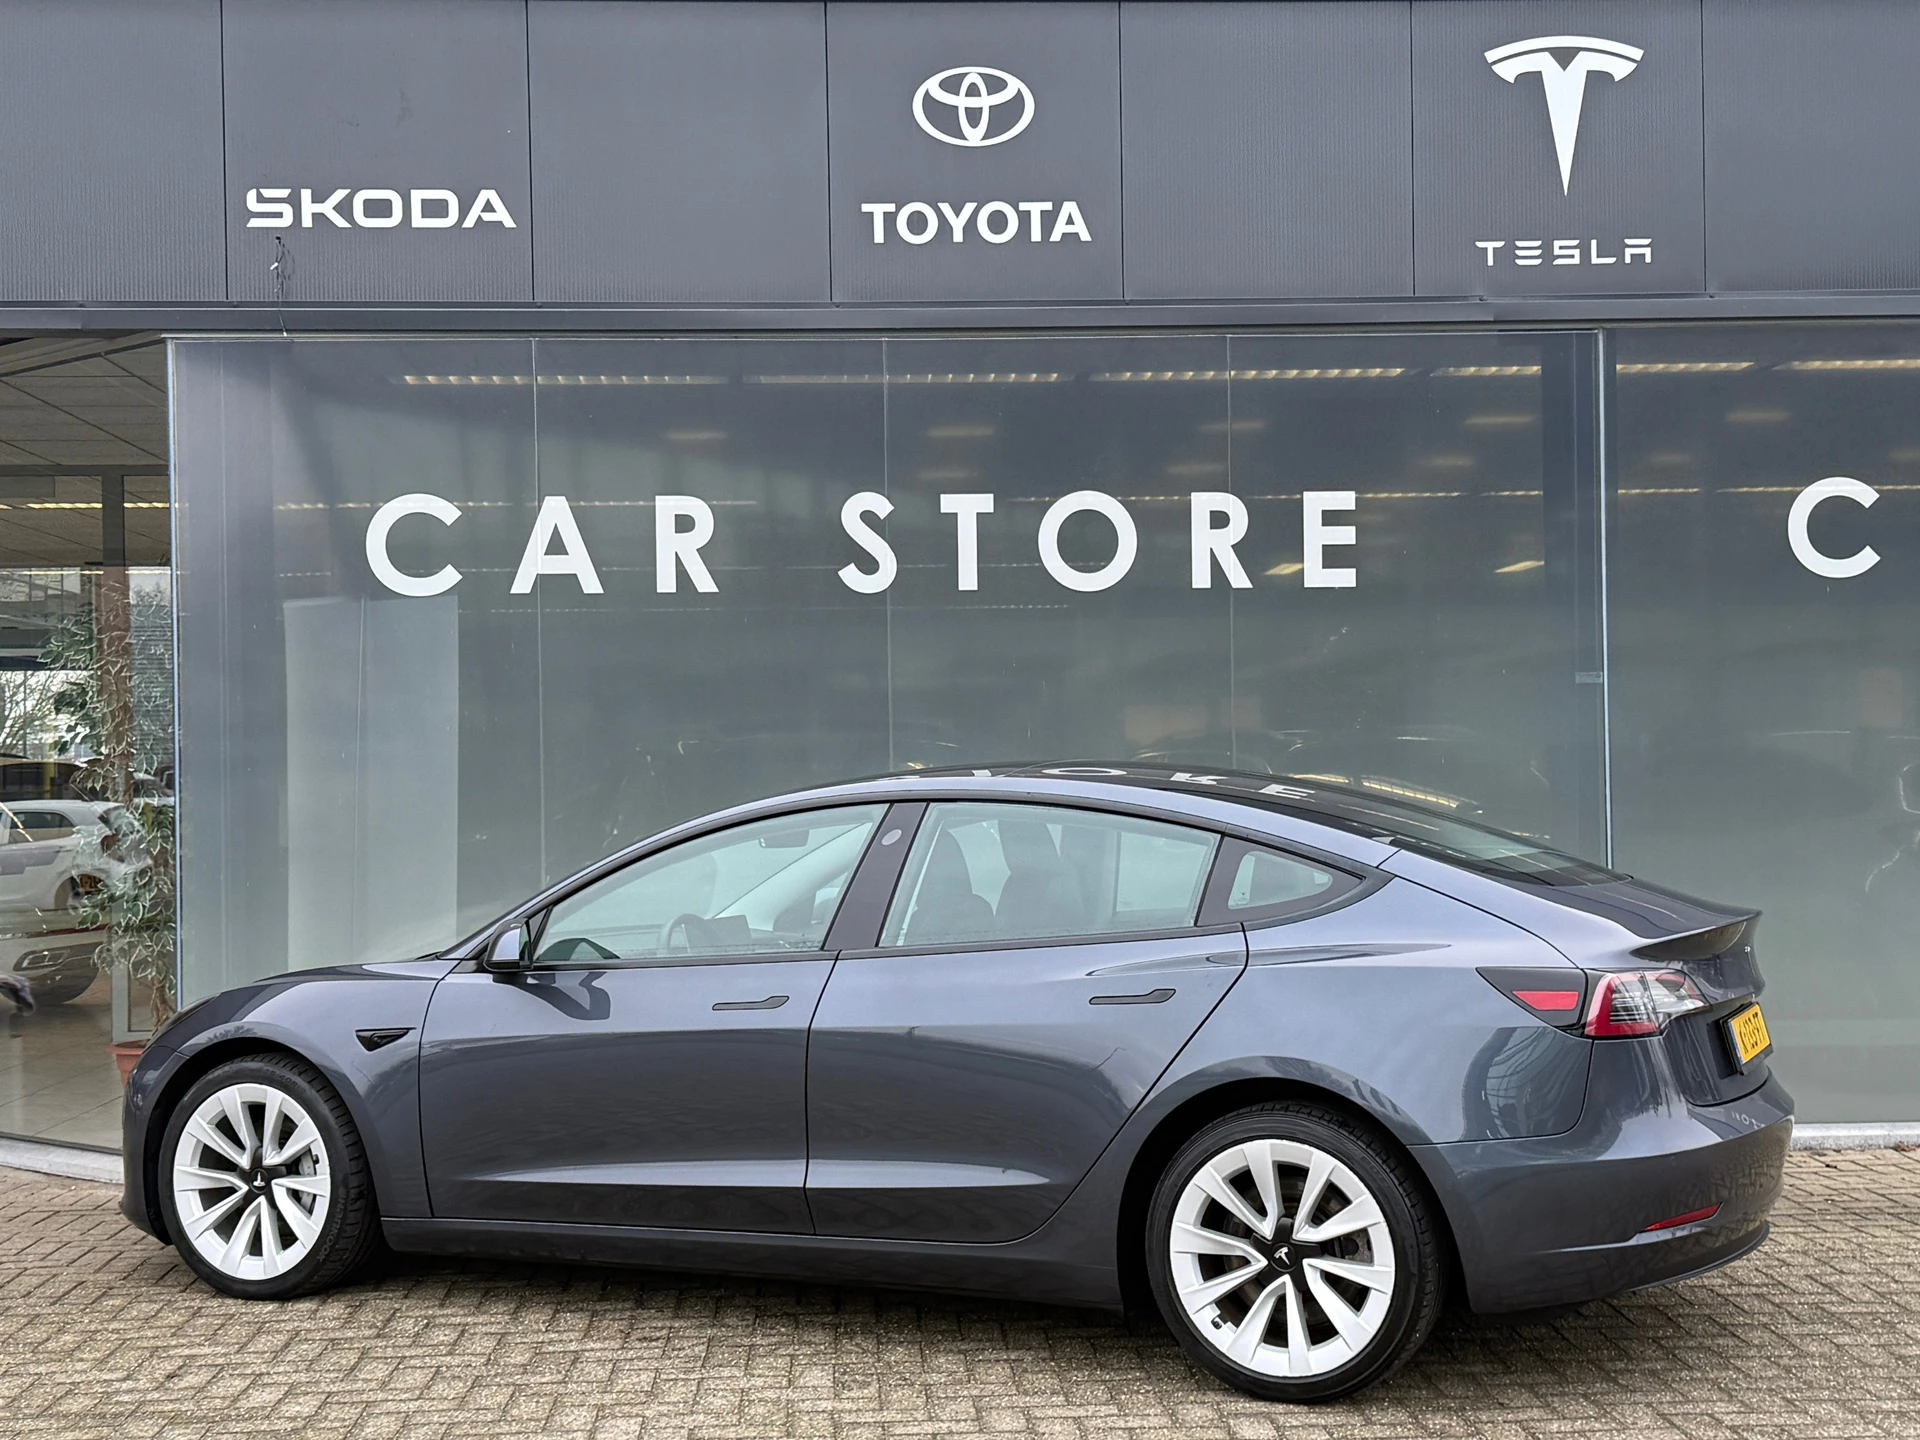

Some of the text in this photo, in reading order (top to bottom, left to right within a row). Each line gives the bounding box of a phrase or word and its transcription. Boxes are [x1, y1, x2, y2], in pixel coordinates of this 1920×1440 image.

[247, 188, 516, 229] SKODA
[861, 201, 1091, 245] TOYOTA
[1475, 238, 1653, 267] TESLA
[365, 490, 1358, 597] CAR STORE
[1787, 476, 1881, 579] C
